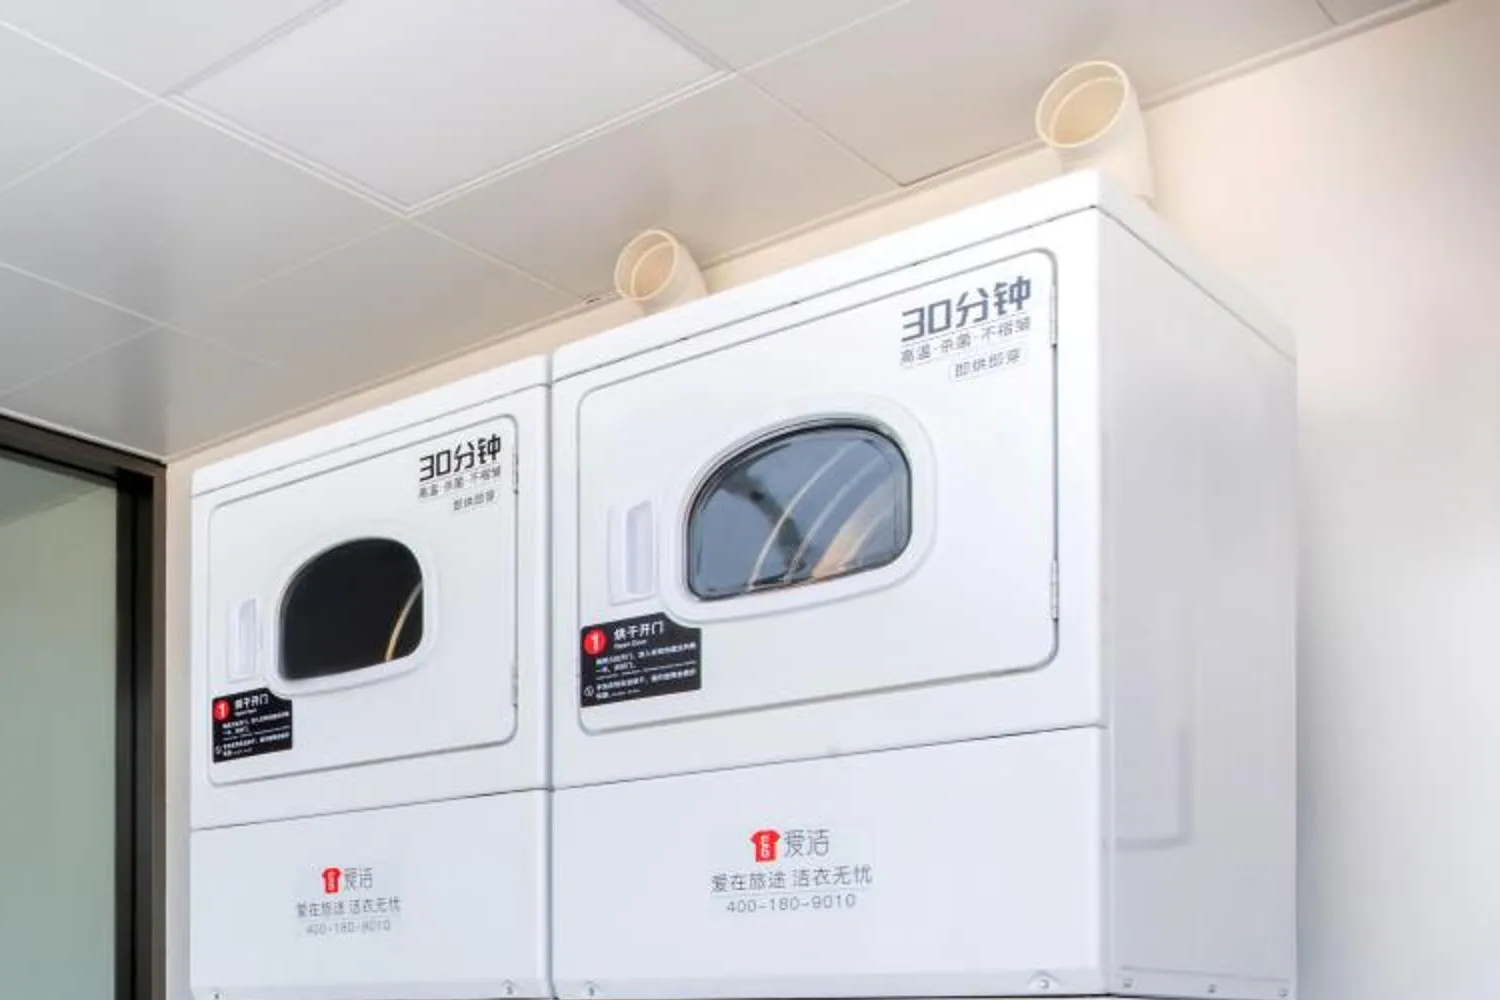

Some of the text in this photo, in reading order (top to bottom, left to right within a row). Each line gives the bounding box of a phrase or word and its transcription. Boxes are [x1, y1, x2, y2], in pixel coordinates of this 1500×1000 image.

[902, 275, 1031, 342] 30分钟
[420, 433, 501, 482] 30分钟
[726, 893, 857, 914] 400-180-9010
